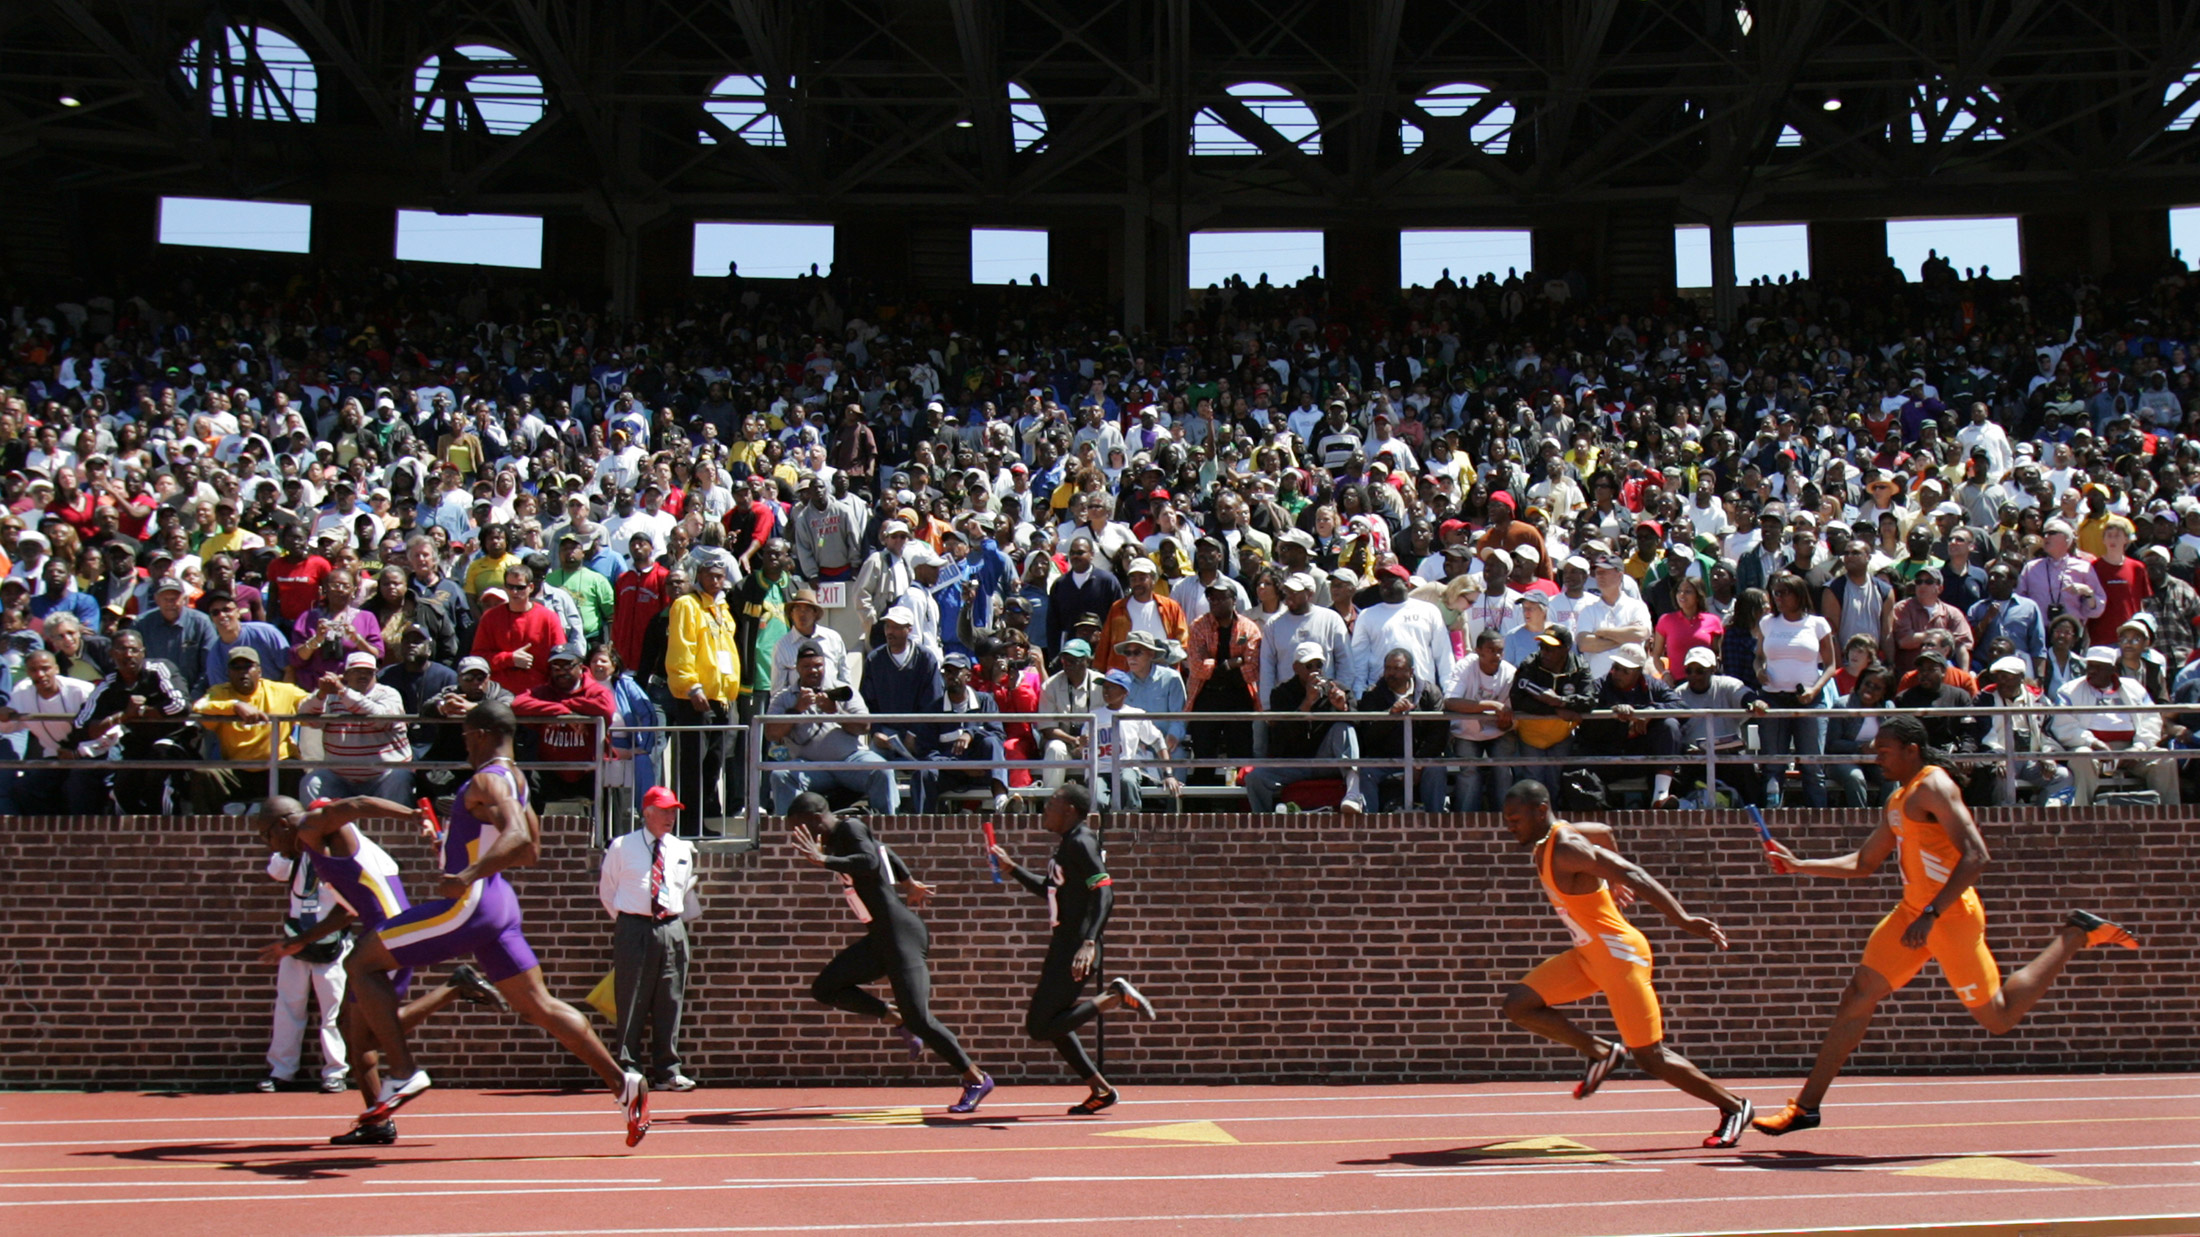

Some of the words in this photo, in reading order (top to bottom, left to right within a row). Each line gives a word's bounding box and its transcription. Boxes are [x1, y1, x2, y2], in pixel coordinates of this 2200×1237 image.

[816, 586, 839, 604] EXIT
[543, 728, 586, 747] CAROLINA
[1956, 983, 1978, 1001] T
